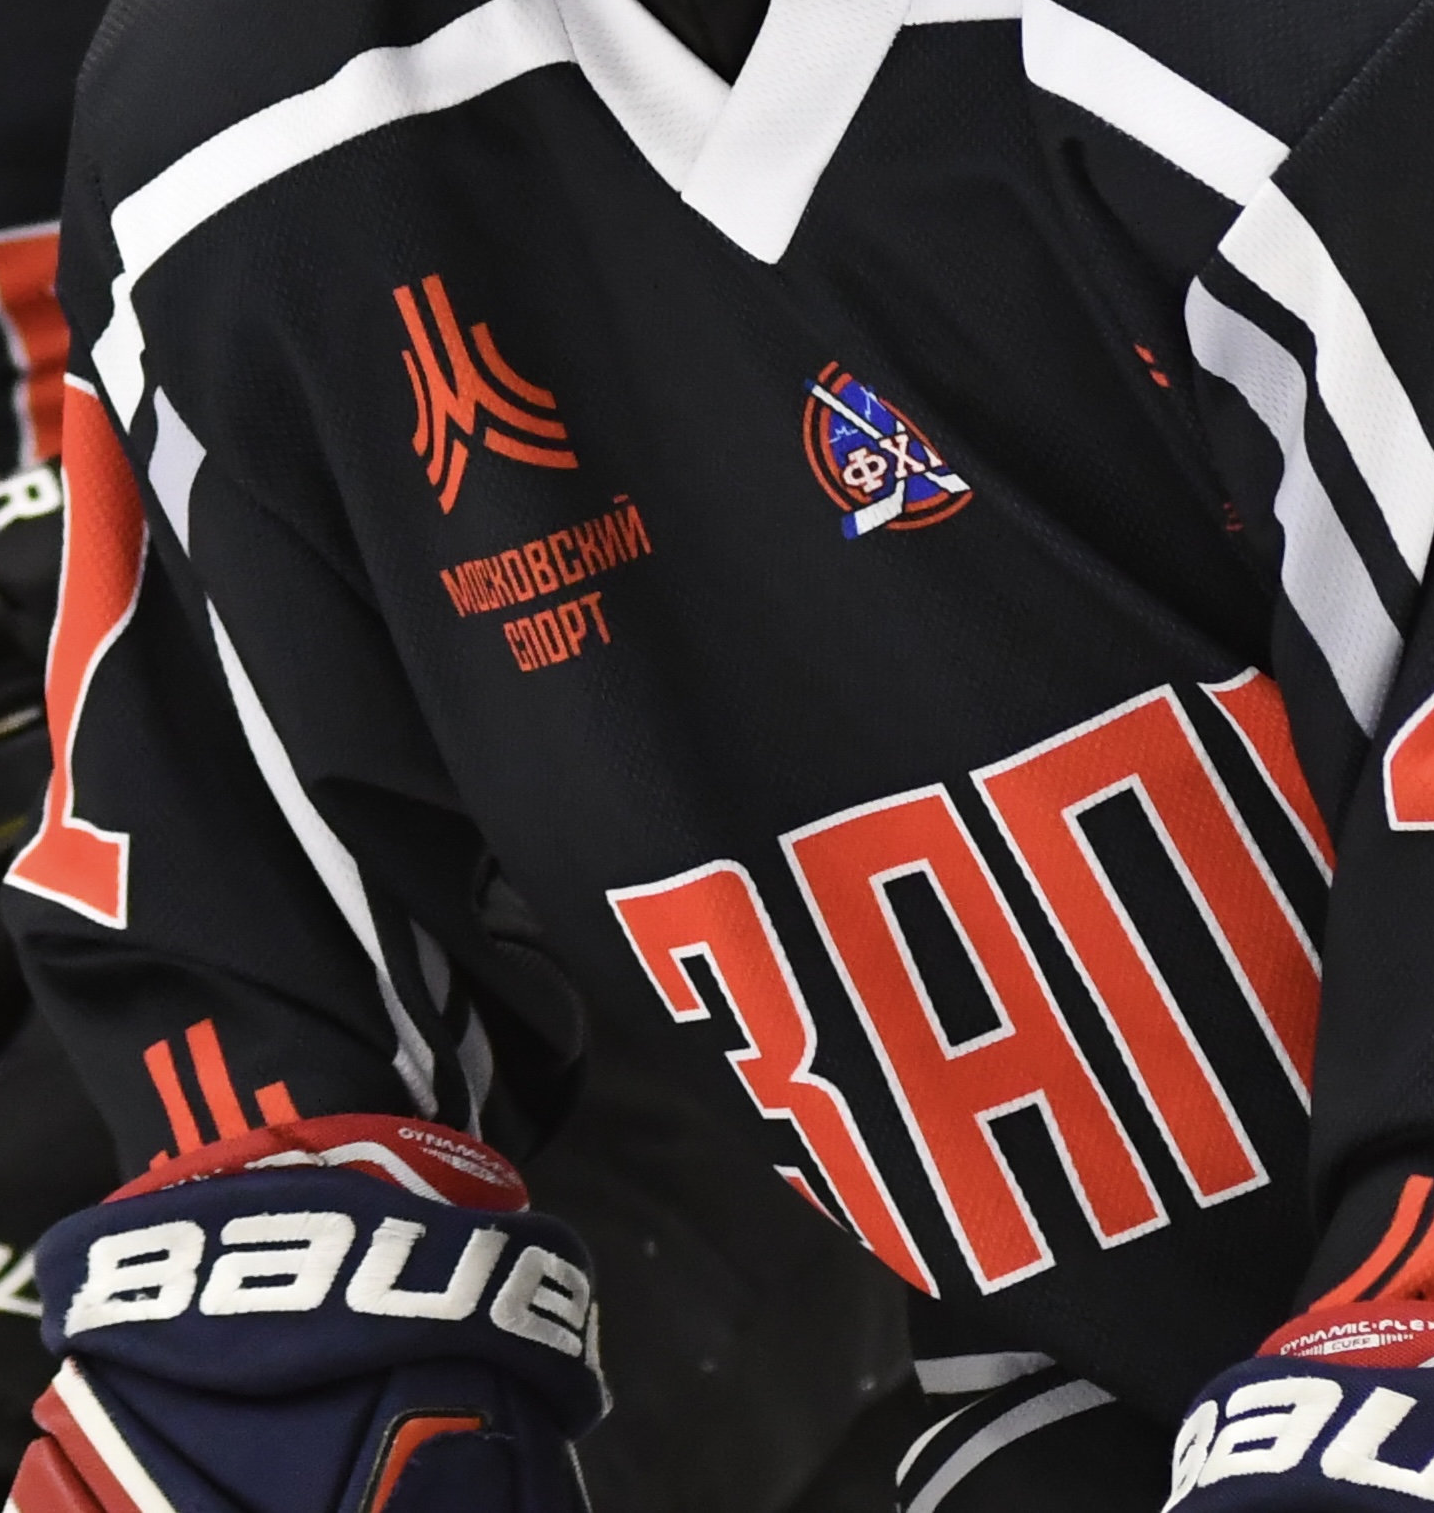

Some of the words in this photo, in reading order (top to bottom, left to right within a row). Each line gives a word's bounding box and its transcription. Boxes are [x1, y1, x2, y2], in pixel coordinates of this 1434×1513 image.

[440, 494, 653, 617] МОСКОВСКИЙ
[502, 590, 611, 673] СПОРТ
[605, 664, 1336, 1300] ЗАП
[65, 1211, 602, 1371] BAUE
